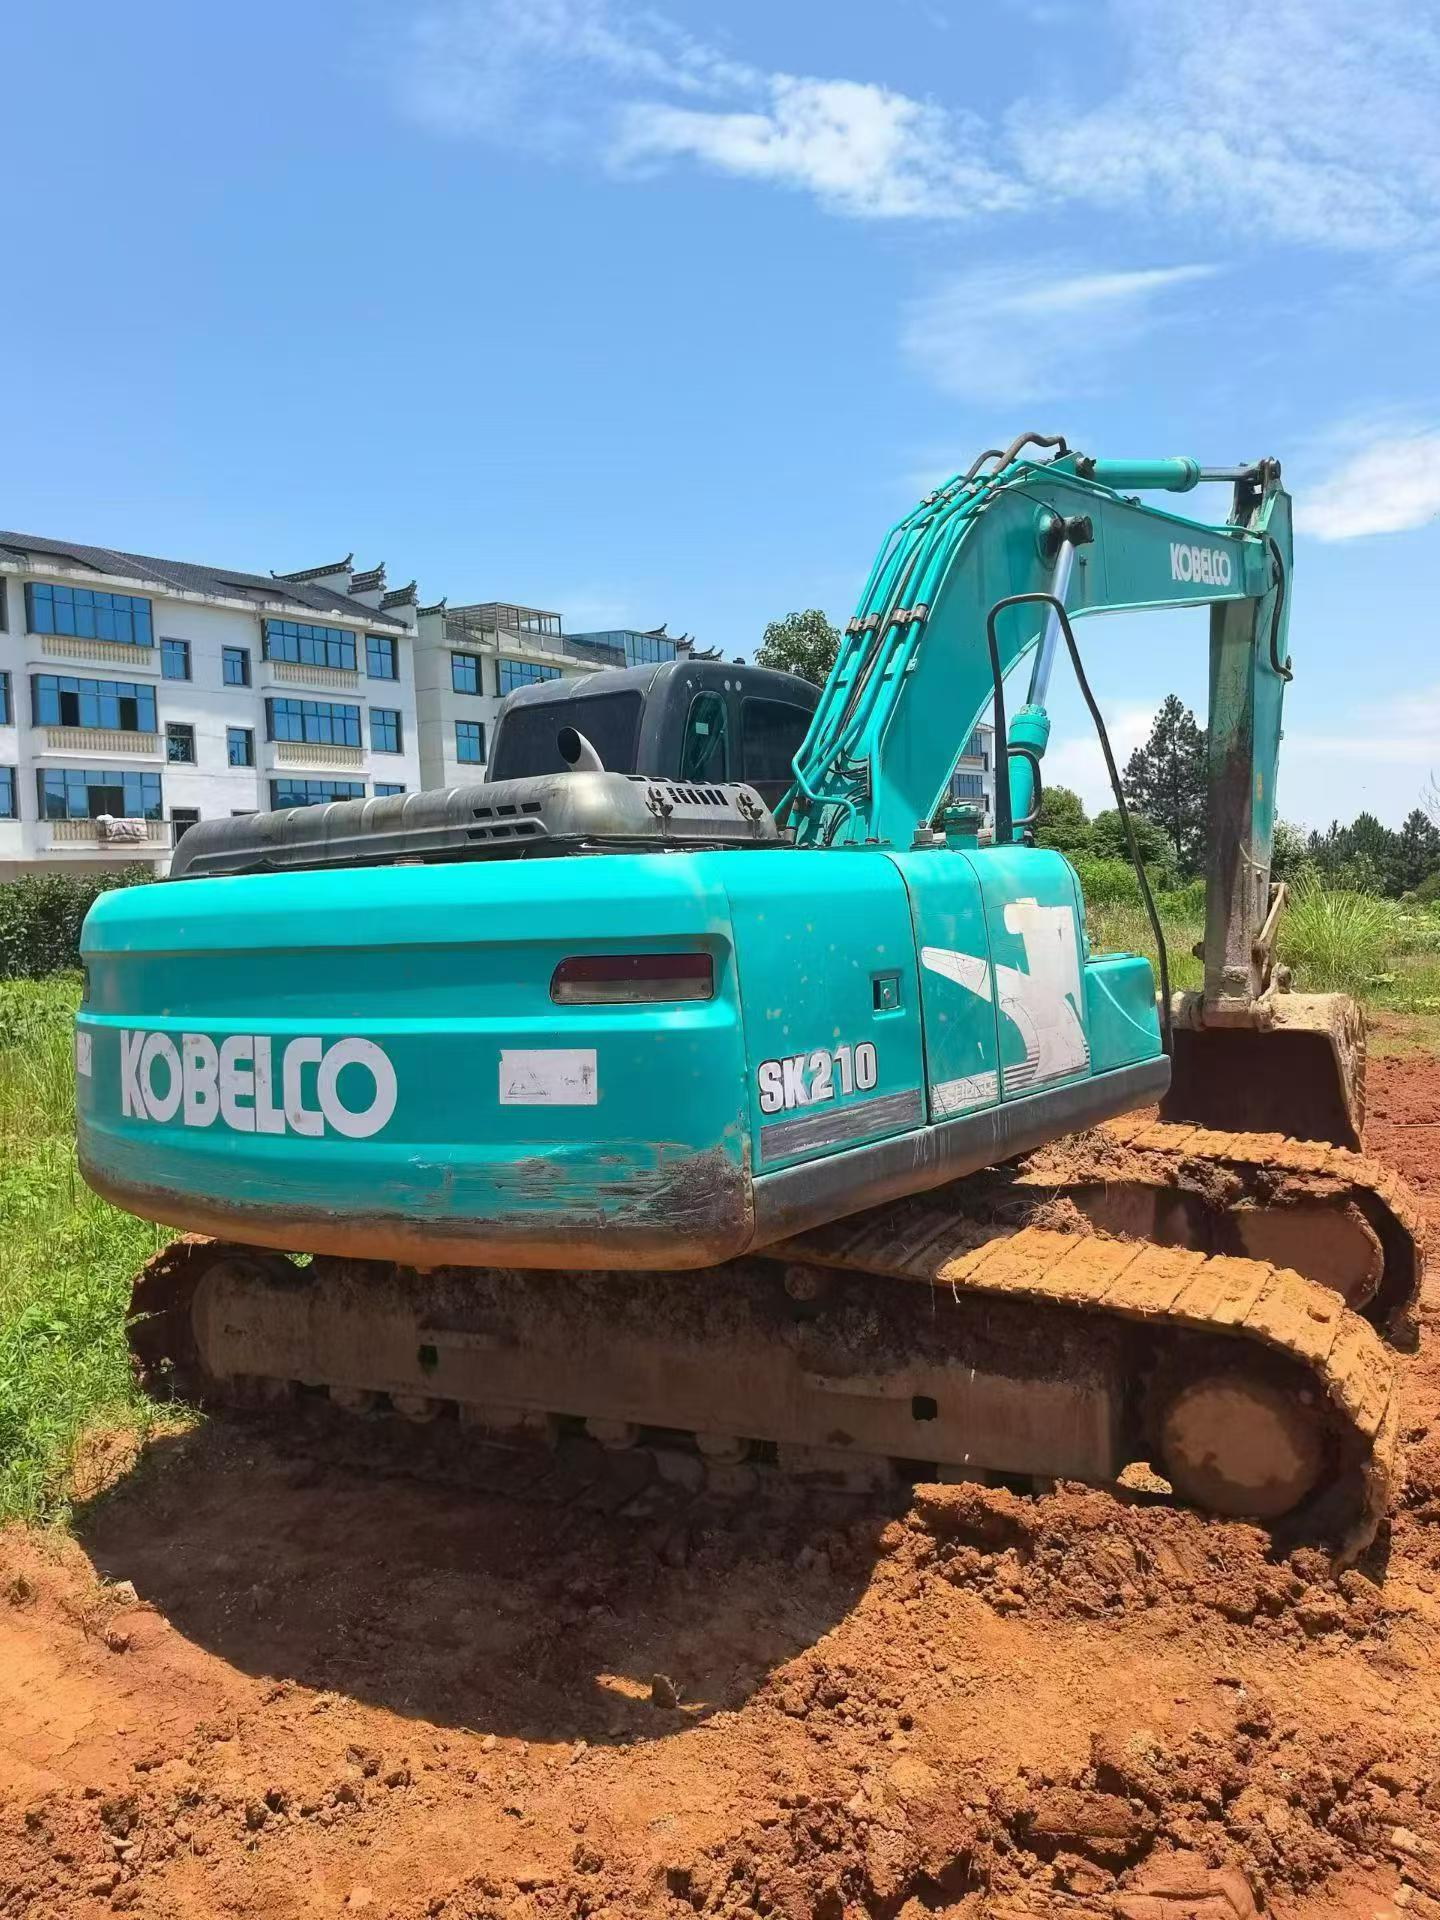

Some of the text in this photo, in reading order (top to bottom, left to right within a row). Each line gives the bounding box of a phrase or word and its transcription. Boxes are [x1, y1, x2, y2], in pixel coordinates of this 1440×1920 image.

[1170, 542, 1231, 586] KOBELCO
[120, 1030, 398, 1138] KOBELCO
[758, 1042, 878, 1114] SK210
